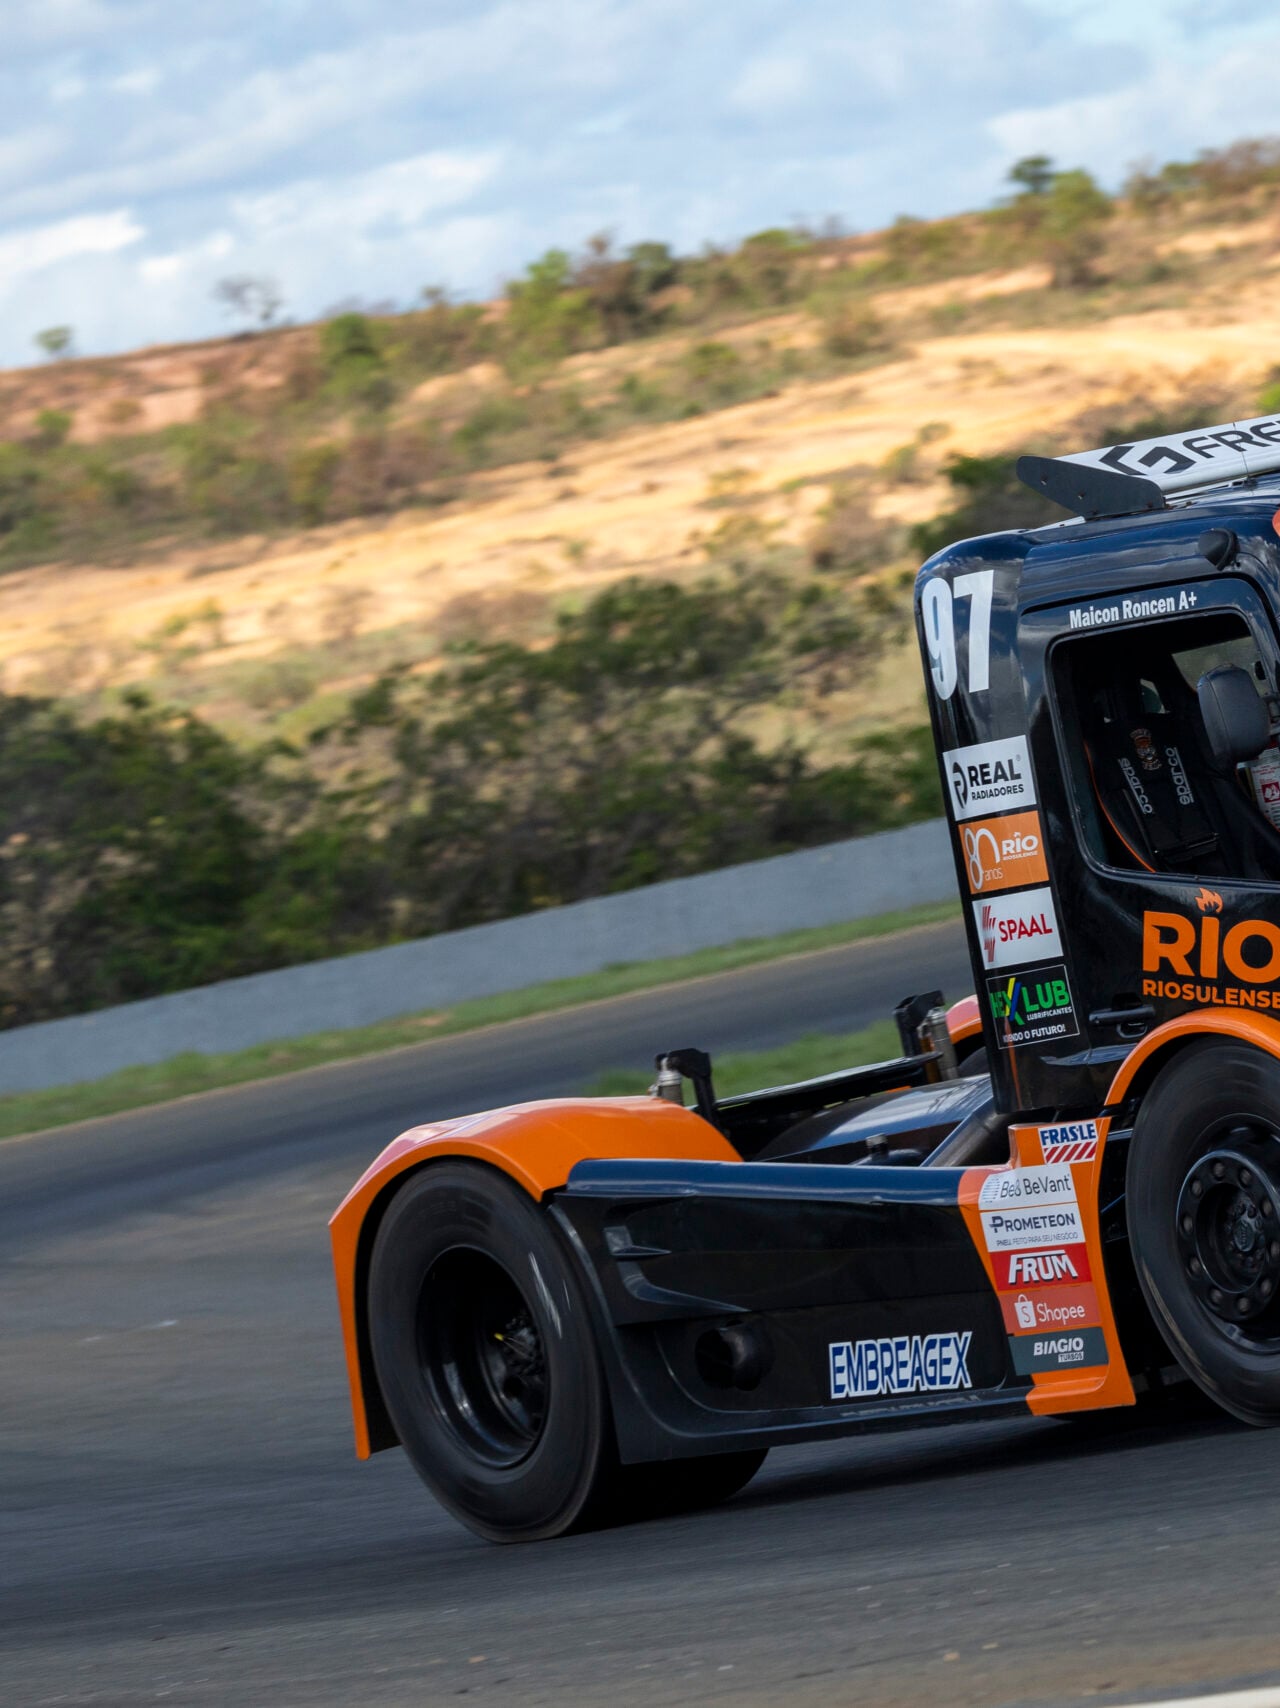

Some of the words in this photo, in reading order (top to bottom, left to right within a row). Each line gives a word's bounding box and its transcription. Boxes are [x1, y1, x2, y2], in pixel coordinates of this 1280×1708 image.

[1069, 606, 1120, 629] Maicon
[1122, 596, 1175, 620] Roncen
[1178, 591, 1197, 611] A+
[921, 570, 994, 700] 97
[967, 759, 1022, 787] REAL
[1117, 756, 1153, 815] sparco
[1165, 746, 1195, 806] sparco
[971, 783, 1025, 801] RADIADORES
[1002, 832, 1039, 856] RIO
[998, 913, 1054, 943] SPAAL
[1026, 1005, 1073, 1021] LUBRIFICANTES
[1031, 1024, 1066, 1038] FUTURO!
[1000, 1180, 1022, 1199] Be8
[1023, 1176, 1071, 1196] BeVant
[989, 1213, 1076, 1234] PROMETEON
[1008, 1249, 1079, 1285] FRUM
[1036, 1302, 1086, 1326] Shopee
[1033, 1337, 1084, 1356] BIAGIO
[829, 1331, 973, 1399] EMBREAGEX
